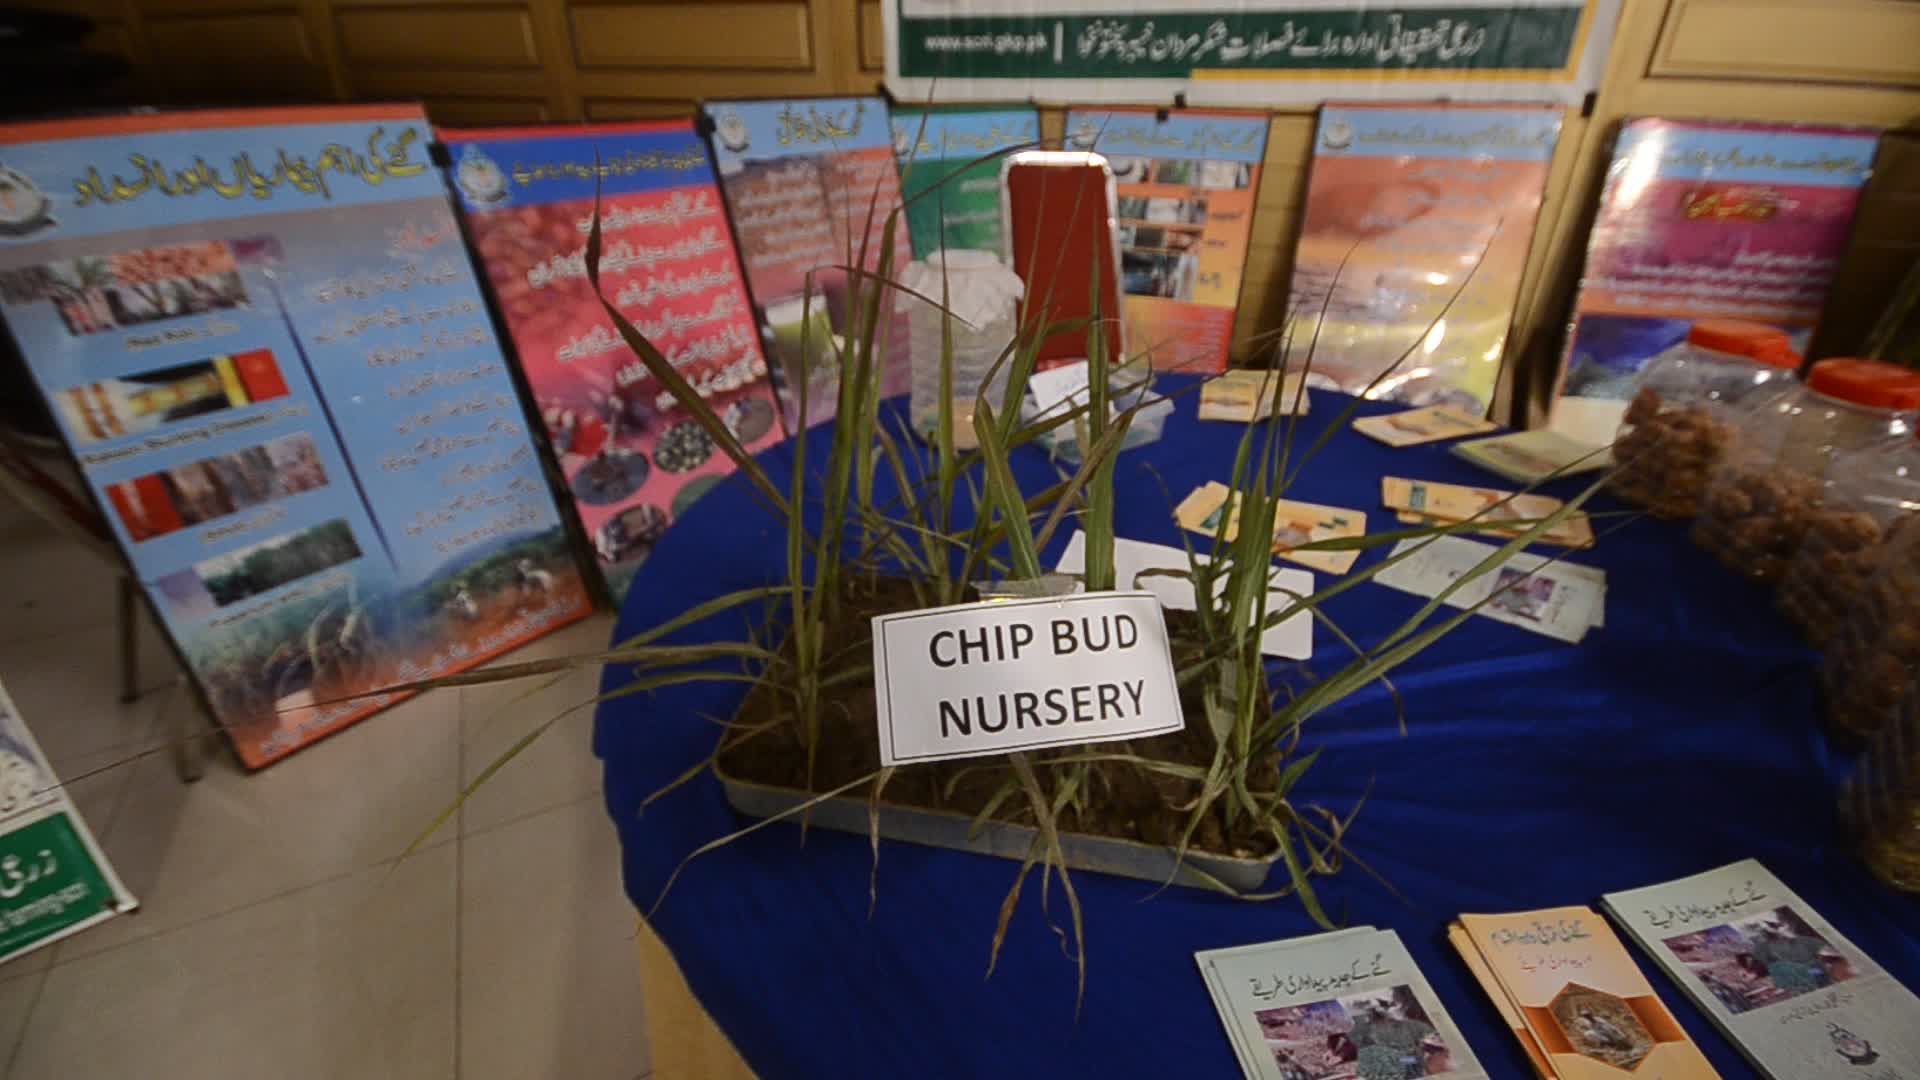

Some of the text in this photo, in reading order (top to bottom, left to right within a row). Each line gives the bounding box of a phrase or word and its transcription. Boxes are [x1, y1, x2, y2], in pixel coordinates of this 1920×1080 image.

[359, 126, 386, 186] کی
[384, 126, 427, 177] گنے
[929, 614, 1138, 668] CHIP BUD
[938, 679, 1145, 738] NURSERY
